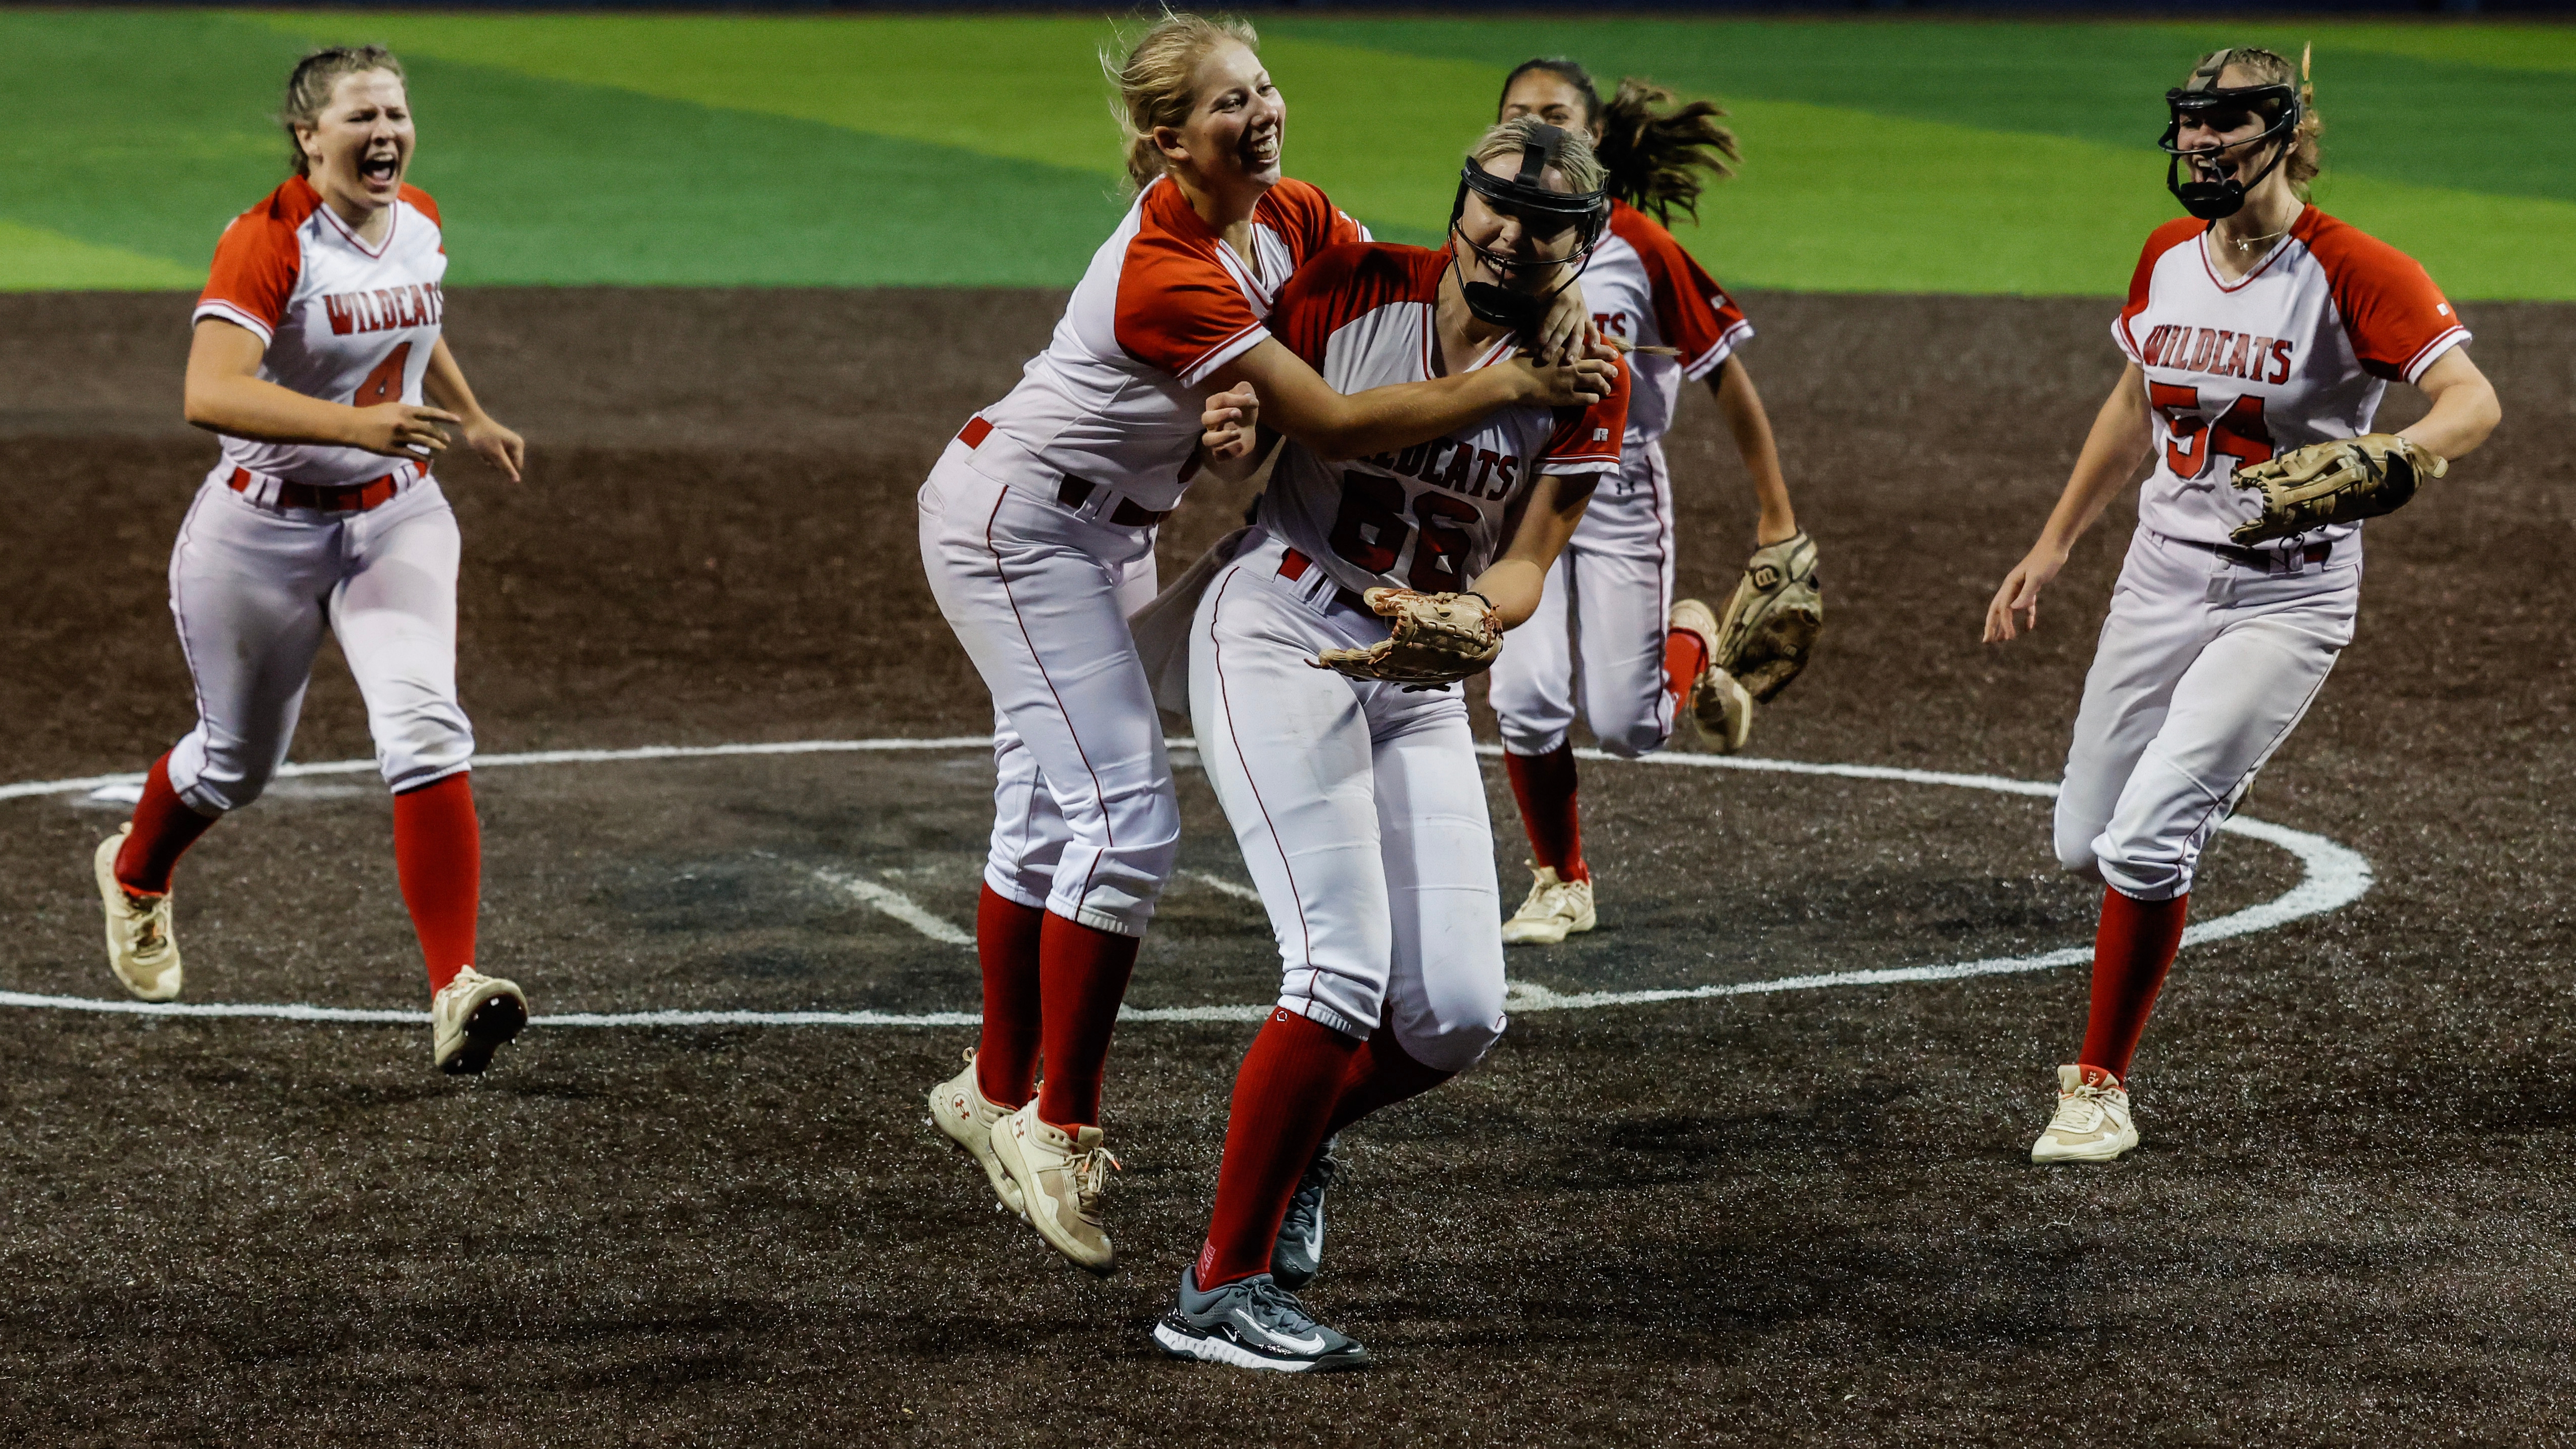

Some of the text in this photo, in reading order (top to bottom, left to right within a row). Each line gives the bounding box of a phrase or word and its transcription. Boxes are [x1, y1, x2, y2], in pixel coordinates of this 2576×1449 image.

[353, 342, 413, 408] 4
[2143, 325, 2293, 385] WILDCATS
[2149, 380, 2275, 479] 54
[1358, 436, 1519, 502] DCATS
[1328, 469, 1480, 594] 66
